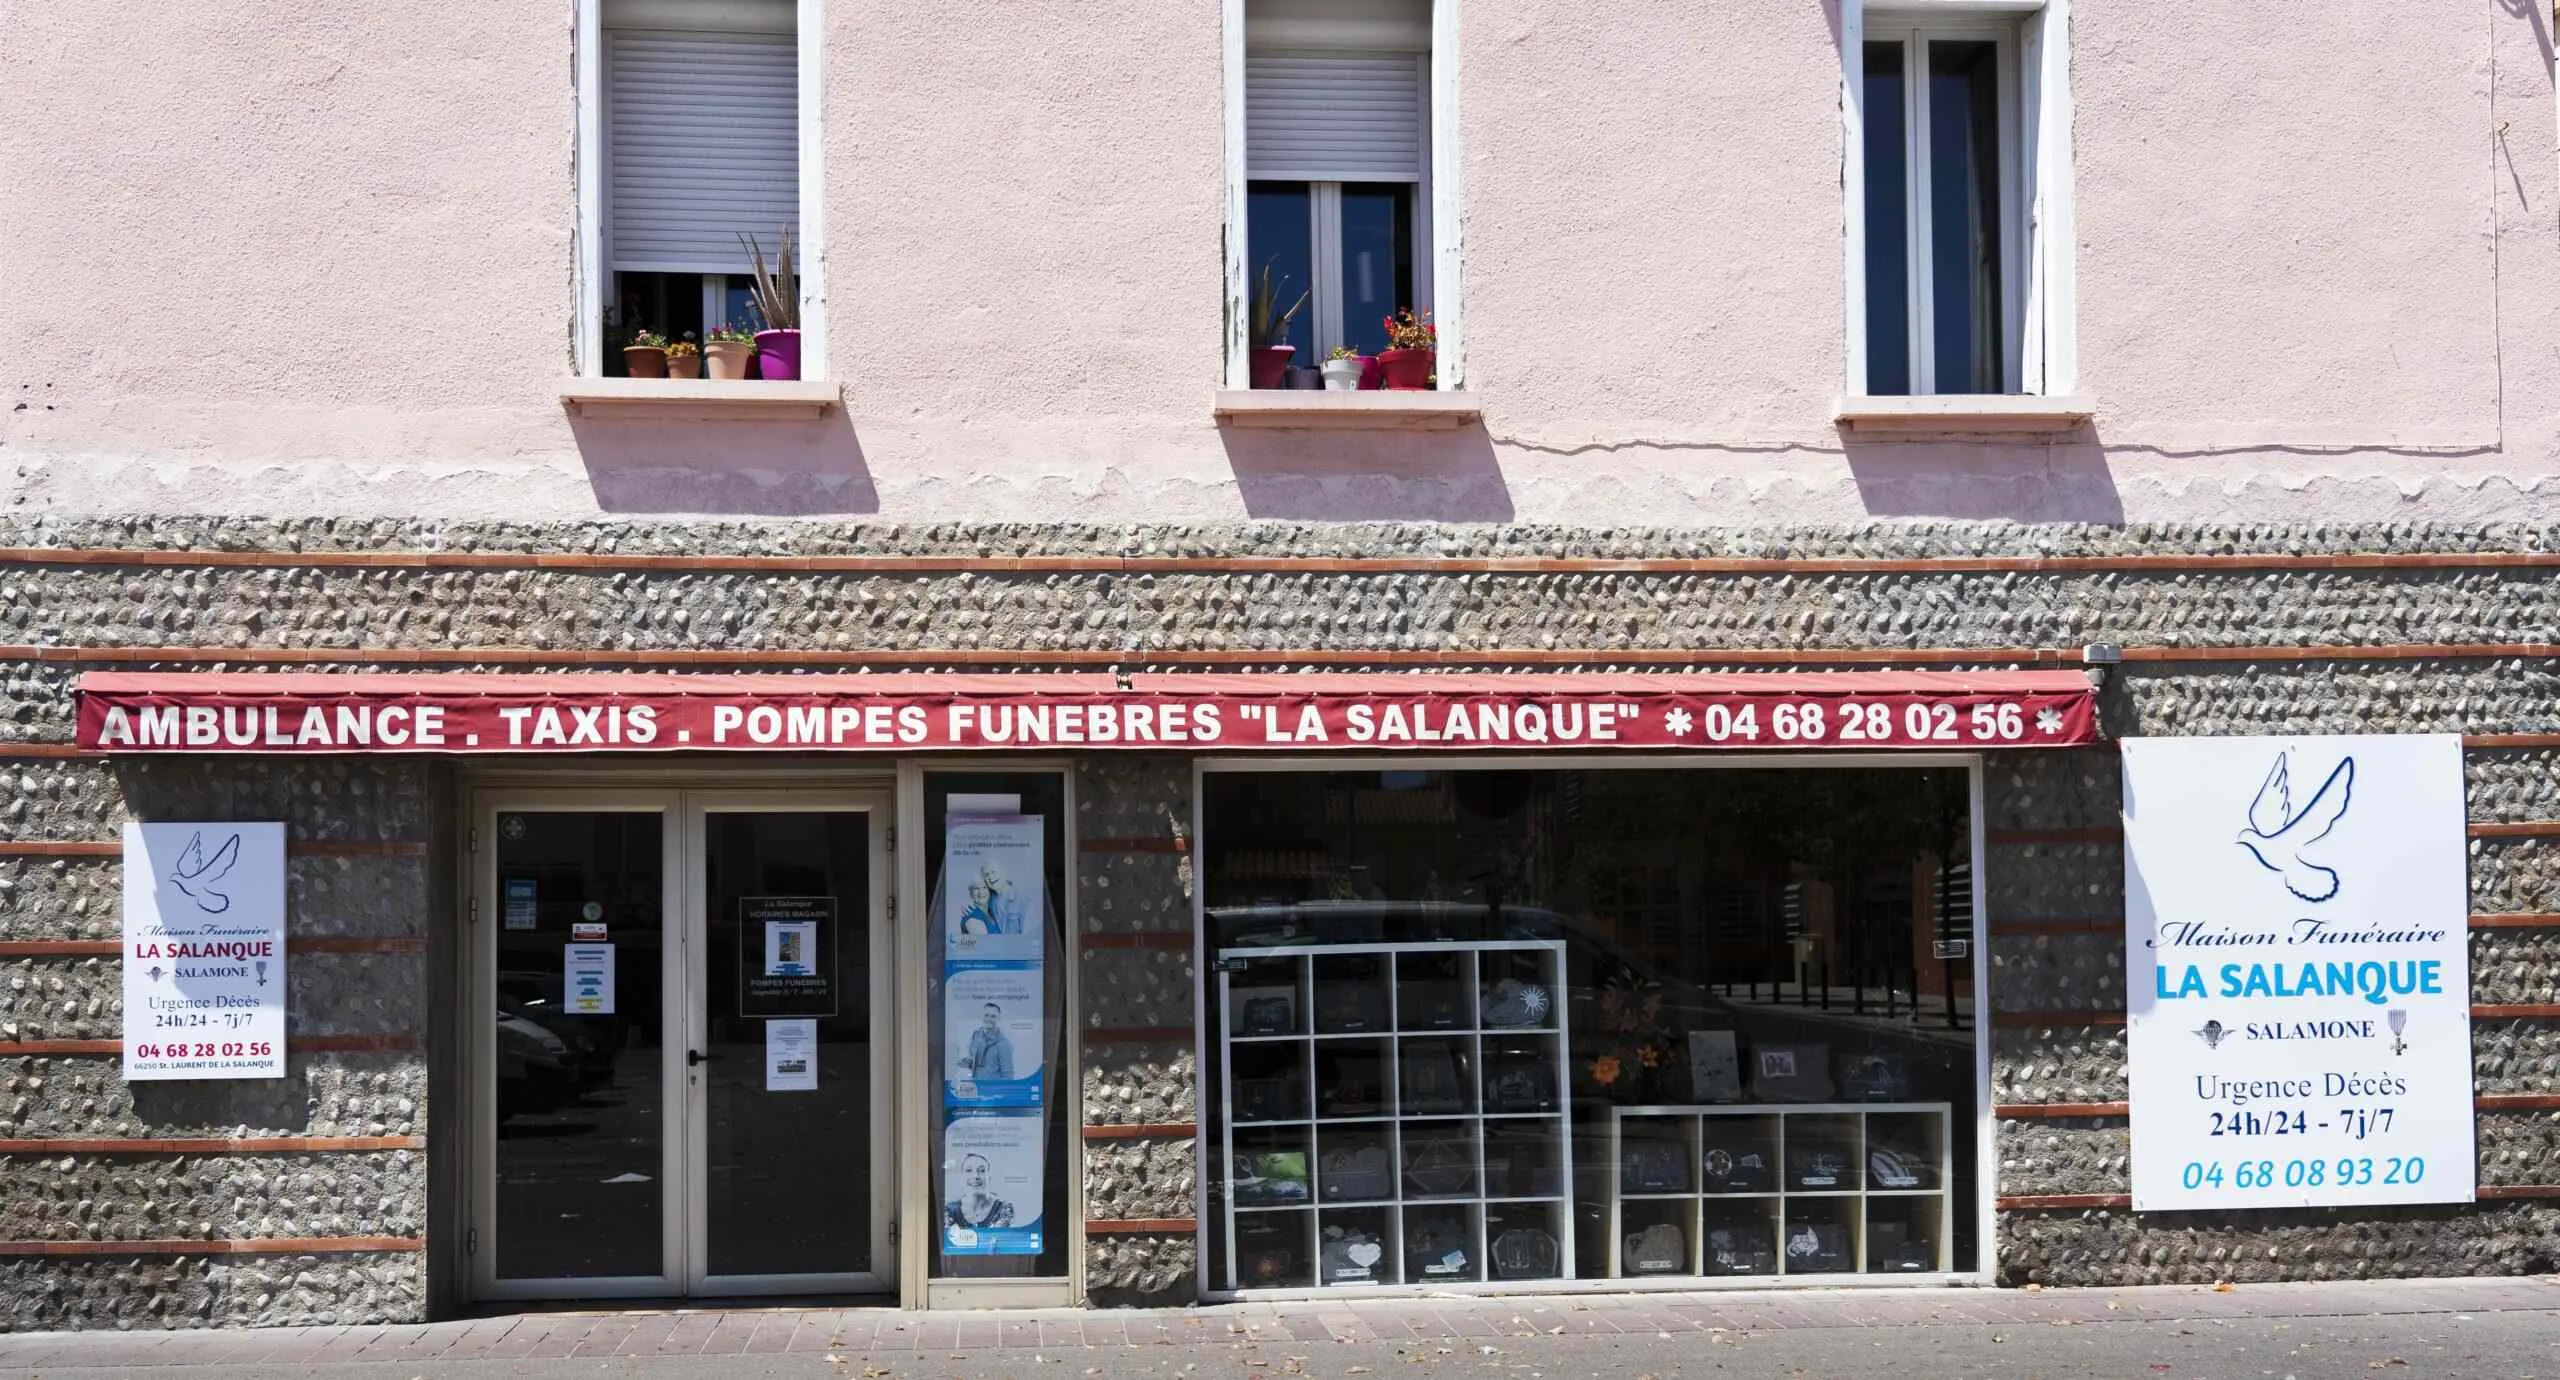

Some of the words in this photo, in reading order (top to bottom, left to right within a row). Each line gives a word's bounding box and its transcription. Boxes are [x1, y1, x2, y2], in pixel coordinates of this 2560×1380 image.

[98, 704, 445, 746] AMBULANCE
[499, 704, 658, 745] TAXIS
[713, 704, 929, 744] POMPES
[948, 703, 1222, 743] FUNEBRES
[1240, 704, 1329, 743] "LA
[1346, 702, 1640, 743] SALANQUE"
[1705, 703, 1760, 741] 04
[1772, 702, 1826, 740] 68
[1839, 702, 1892, 740] 28
[1905, 702, 1959, 740] 02
[1971, 702, 2024, 740] 56
[137, 926, 196, 937] Maison
[199, 923, 271, 936] Funéraire
[2145, 919, 2278, 949] Maison
[2287, 918, 2446, 946] Funéraire
[136, 943, 161, 959] LA
[167, 941, 273, 961] SALANQUE
[174, 966, 249, 978] SALAMONE
[2156, 964, 2208, 1000] LA
[2220, 960, 2443, 1005] SALANQUE
[148, 997, 210, 1012] Urgence
[215, 994, 260, 1008] Décès
[155, 1014, 207, 1028] 24h/24
[224, 1013, 253, 1029] 7j/7
[2246, 1020, 2376, 1041] SALAMONE
[138, 1044, 160, 1058] 04
[166, 1043, 188, 1057] 68
[194, 1043, 215, 1057] 28
[222, 1042, 244, 1056] 02
[249, 1041, 271, 1056] 56
[171, 1061, 206, 1070] LAURENT
[232, 1060, 274, 1069] SALANQUE
[2196, 1074, 2312, 1106] Urgence
[2323, 1071, 2408, 1098] Décès
[2208, 1109, 2308, 1137] 24h/24
[2339, 1107, 2396, 1141] 7j/7
[2182, 1160, 2225, 1190] 04
[2235, 1159, 2275, 1189] 68
[2284, 1159, 2326, 1188] 08
[2335, 1157, 2374, 1187] 93
[2383, 1156, 2426, 1185] 20
